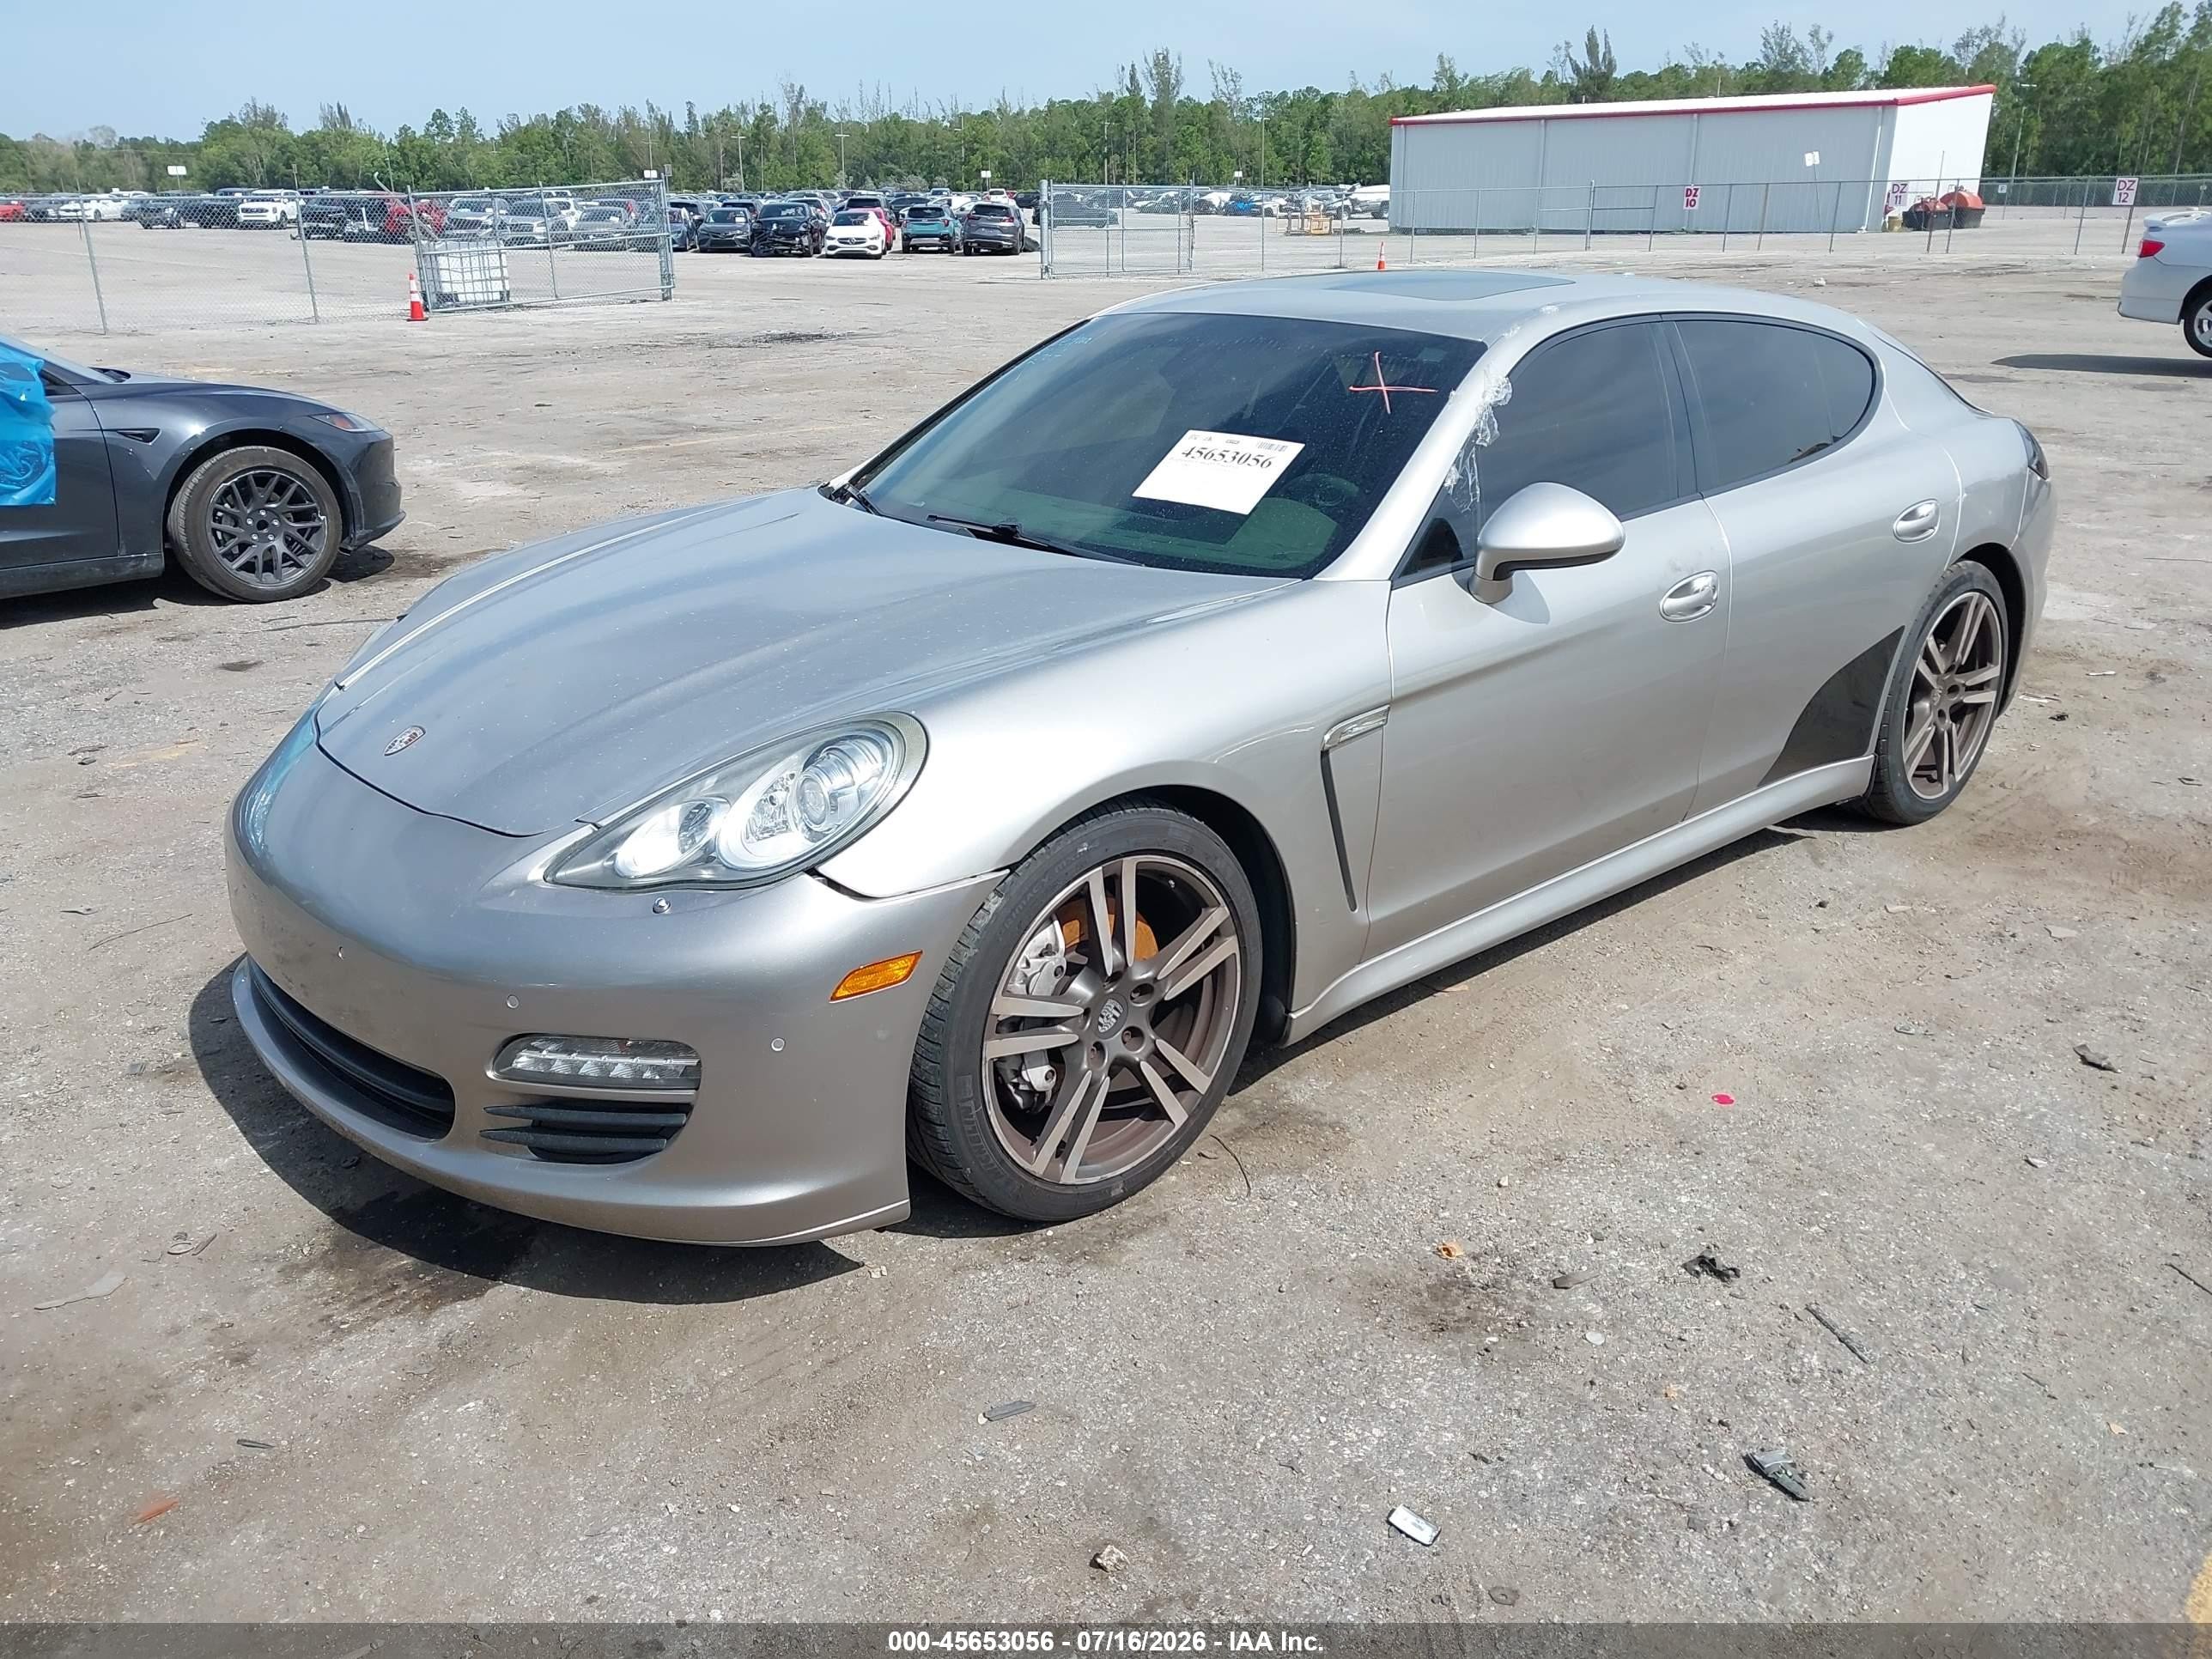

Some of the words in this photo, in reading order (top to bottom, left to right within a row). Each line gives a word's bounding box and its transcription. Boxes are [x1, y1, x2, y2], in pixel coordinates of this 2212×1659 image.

[1892, 183, 1907, 193] DZ
[2118, 179, 2136, 191] DZ
[1686, 188, 1698, 198] DZ
[2118, 191, 2129, 203] 12
[1686, 198, 1696, 208] 10
[1894, 195, 1901, 204] 11
[1182, 446, 1276, 469] 45653056
